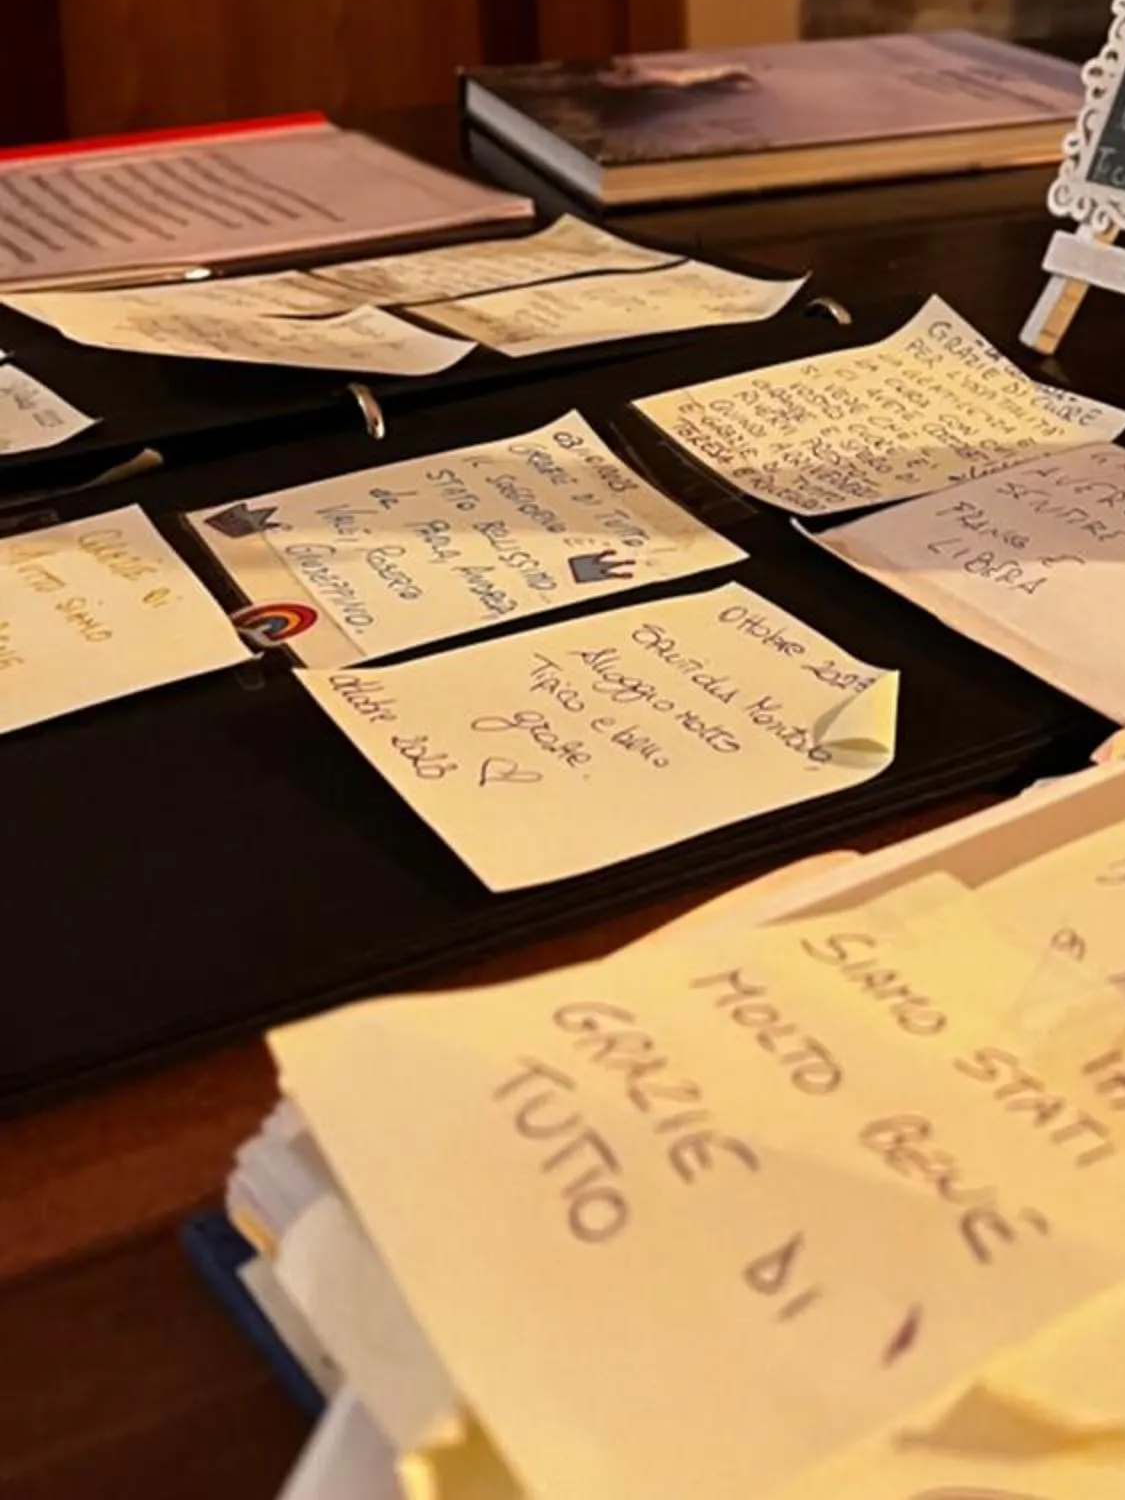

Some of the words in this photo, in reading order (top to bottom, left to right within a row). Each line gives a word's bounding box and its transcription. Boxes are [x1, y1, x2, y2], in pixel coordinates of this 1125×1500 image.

[928, 321, 1000, 380] GRAZIE
[426, 468, 481, 512] STATO
[927, 538, 1049, 595] LIBERA
[718, 606, 805, 657] Ottobre
[689, 967, 844, 1097] MOLTO
[801, 931, 948, 1037] SIAMO
[952, 1045, 1119, 1169] STATI
[492, 1055, 631, 1245] TUTTO
